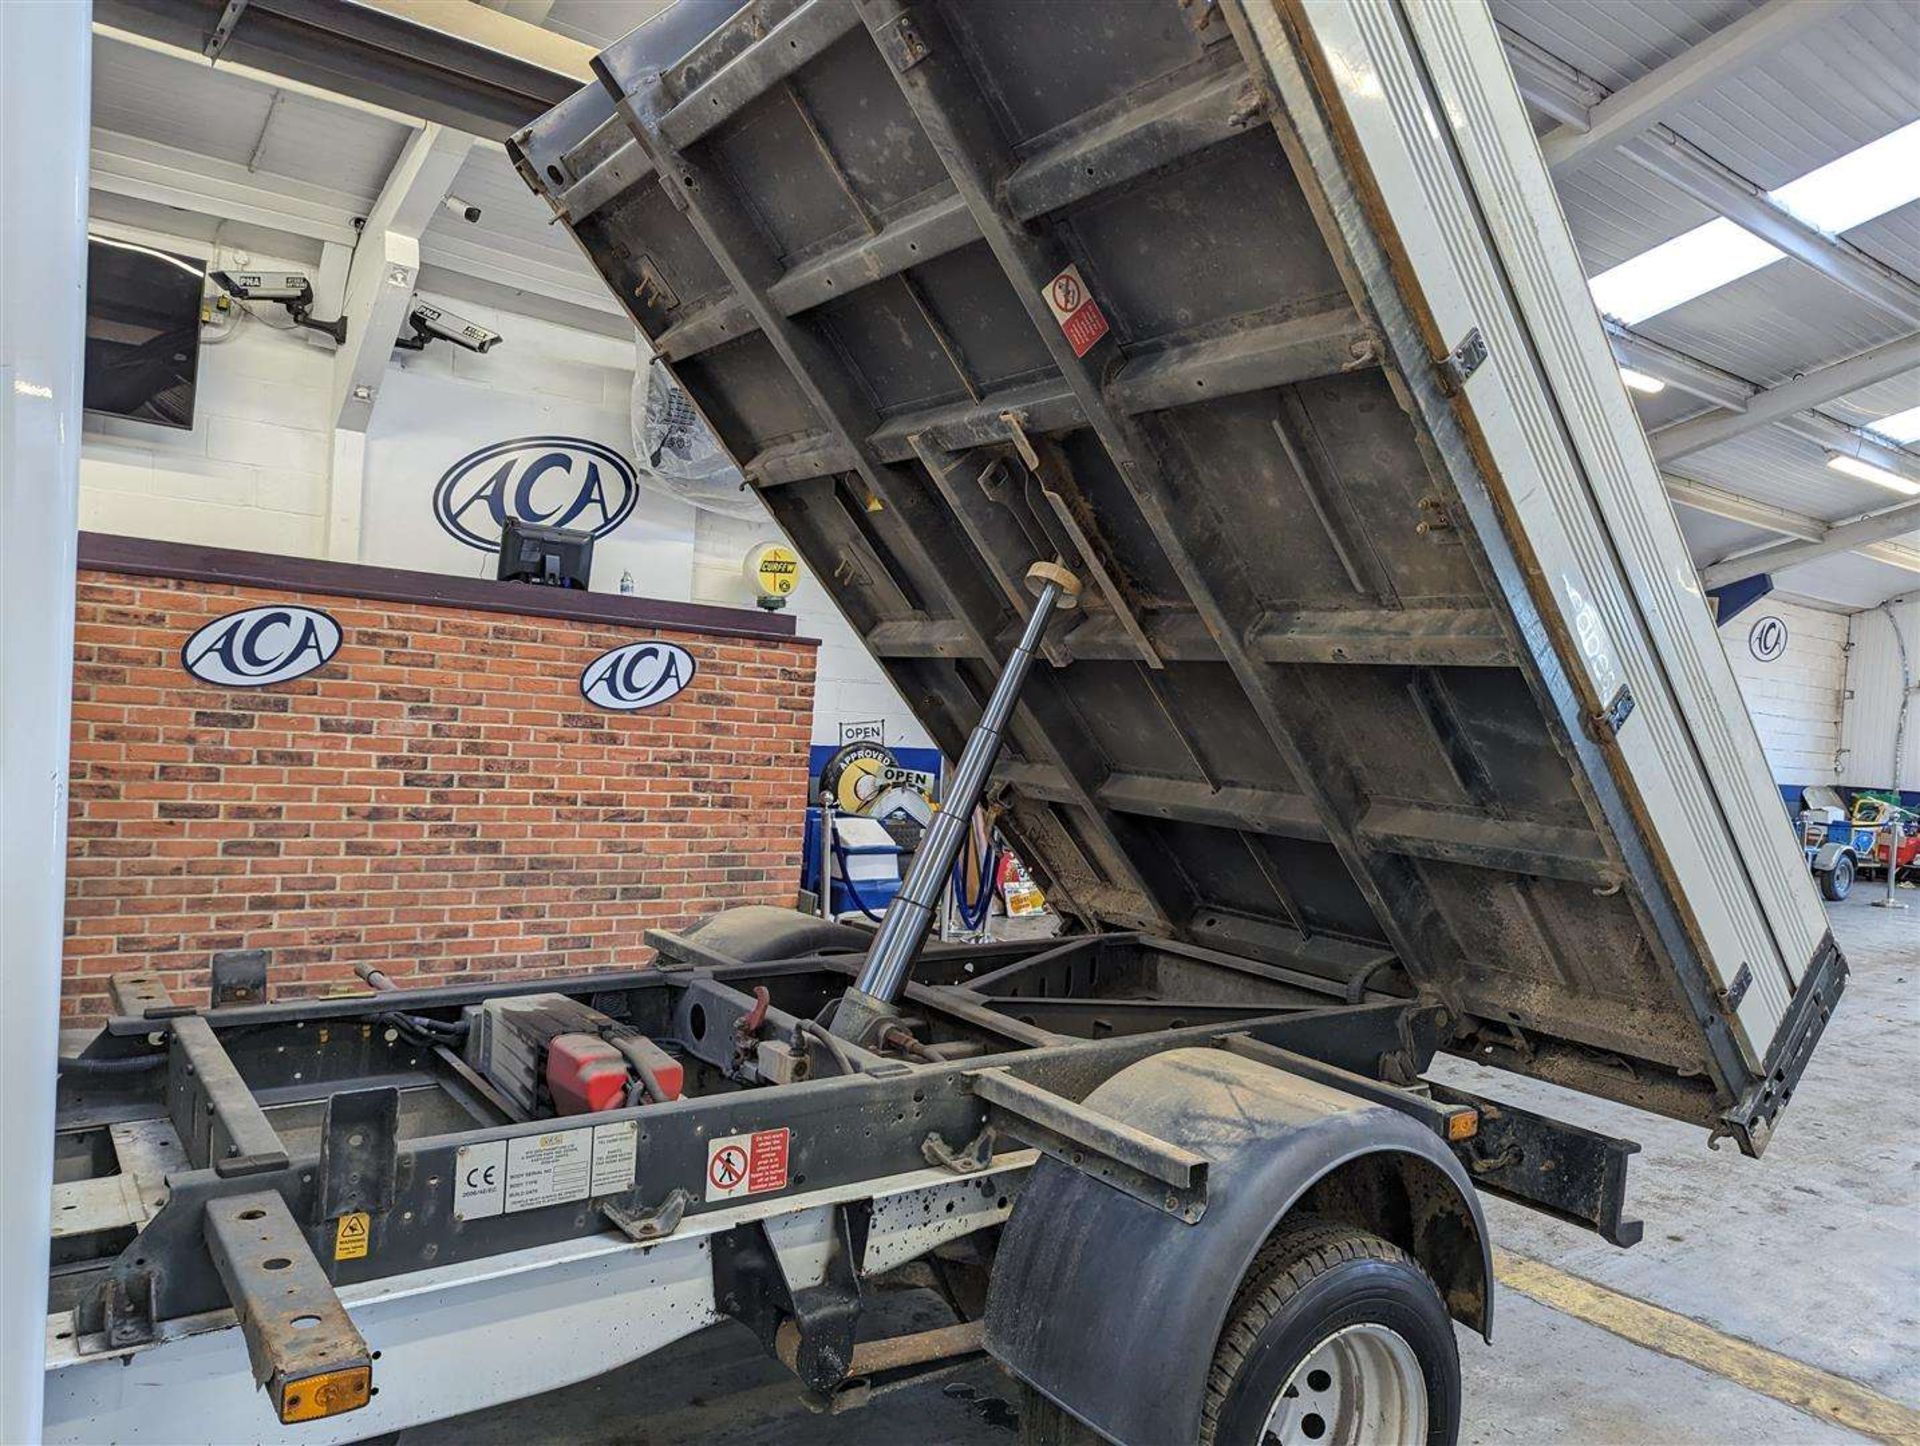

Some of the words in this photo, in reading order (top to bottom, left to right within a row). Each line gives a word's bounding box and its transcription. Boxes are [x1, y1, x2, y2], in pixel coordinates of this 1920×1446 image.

[452, 452, 610, 529] ACA
[761, 561, 796, 573] CURFEW
[189, 611, 326, 677] ACA
[1752, 621, 1782, 656] ACA
[585, 646, 682, 702] ACA
[845, 727, 880, 739] OPEN
[840, 749, 890, 770] APPROVED
[884, 769, 927, 784] OPEN
